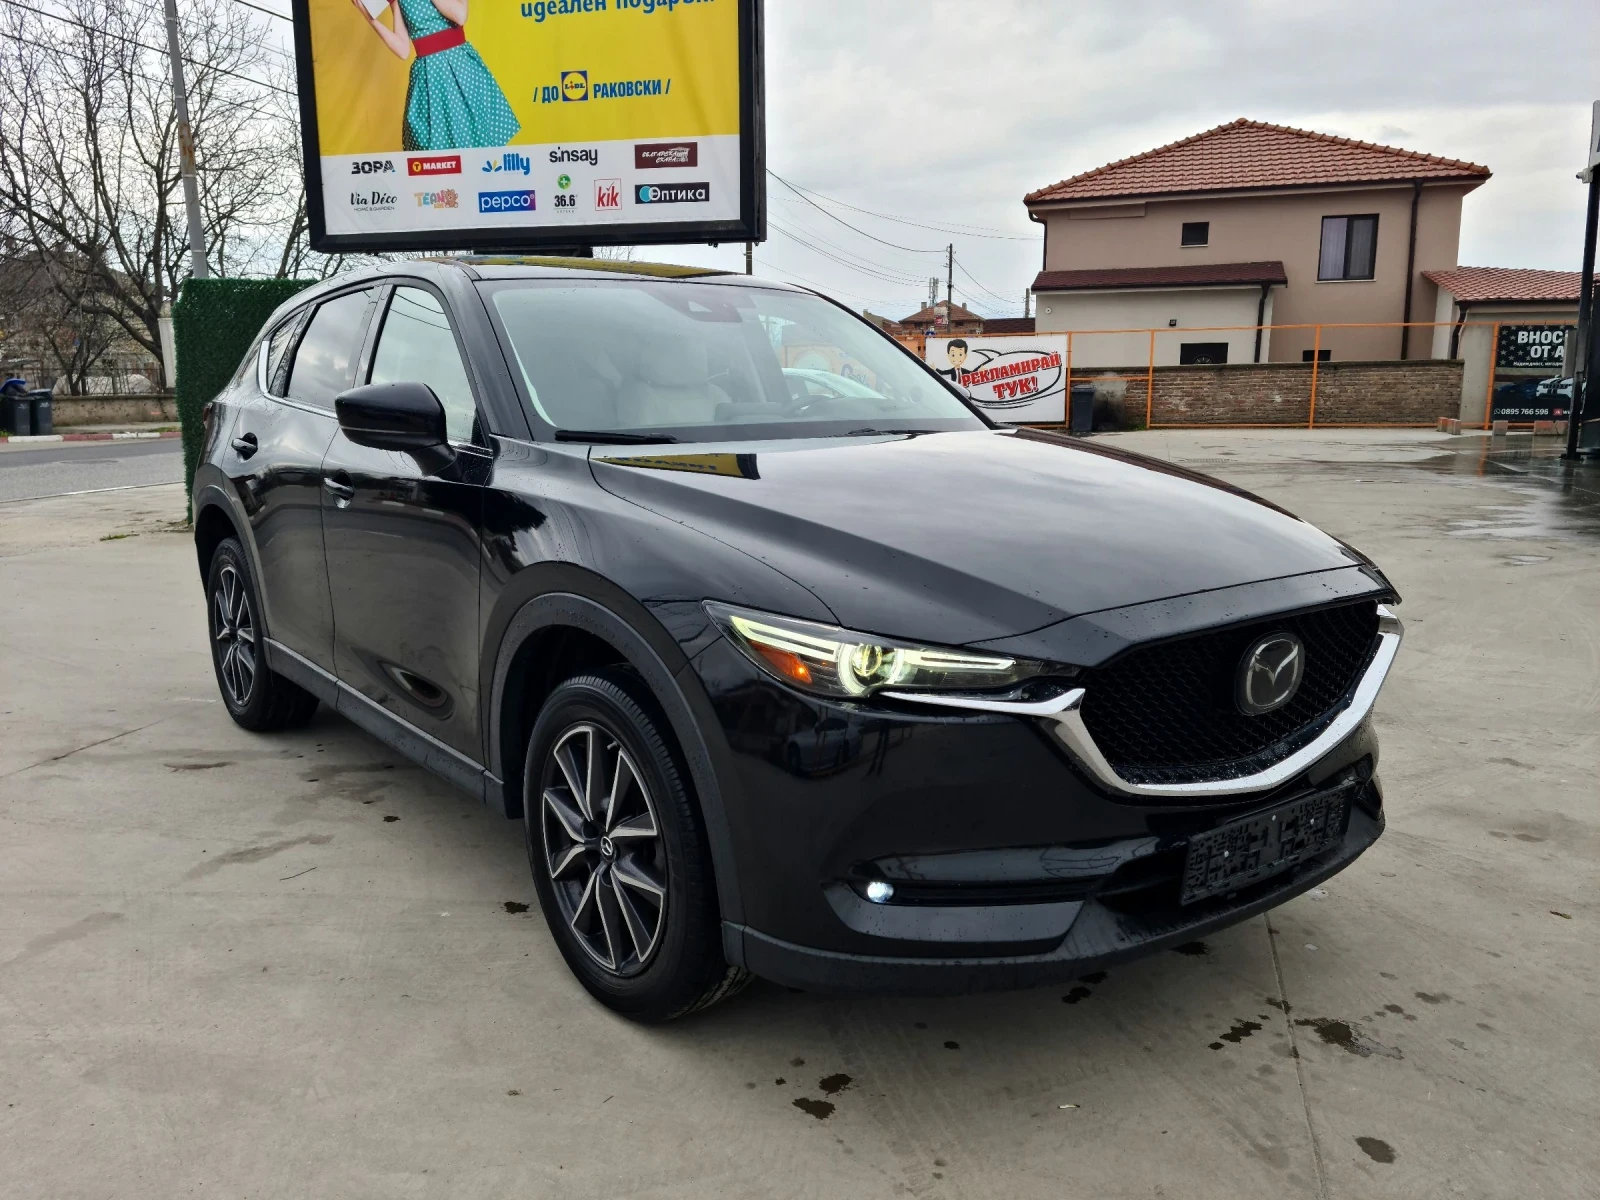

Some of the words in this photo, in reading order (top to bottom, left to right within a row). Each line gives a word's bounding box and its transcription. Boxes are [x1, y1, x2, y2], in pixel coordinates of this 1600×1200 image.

[541, 86, 560, 103] ДО
[593, 79, 662, 99] РАКОВСКИ
[423, 161, 457, 171] MARKET
[503, 153, 531, 176] lilly
[549, 146, 598, 166] sinsay
[351, 192, 369, 205] Via
[371, 191, 398, 206] Déco
[1530, 345, 1551, 358] ОТ
[961, 352, 1062, 388] РЕКЛАМИРАЙ
[993, 376, 1039, 400] ТУК!
